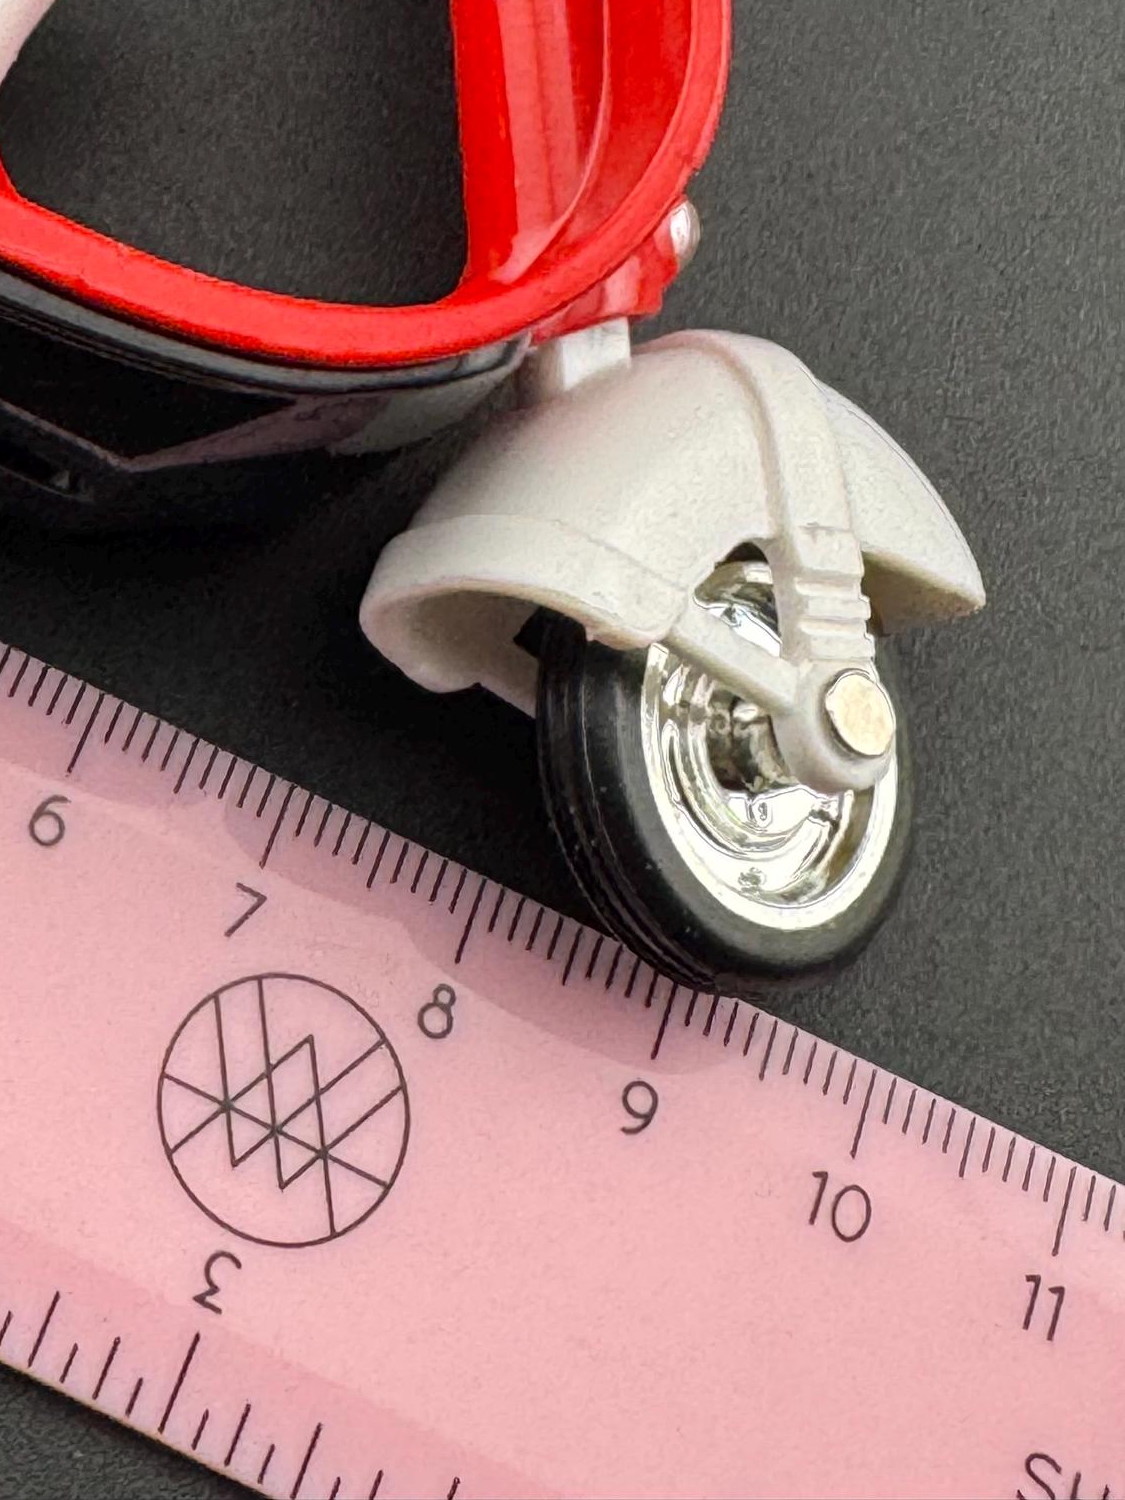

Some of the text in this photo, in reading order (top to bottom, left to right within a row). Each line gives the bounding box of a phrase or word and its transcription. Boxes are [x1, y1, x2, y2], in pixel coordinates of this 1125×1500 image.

[28, 795, 71, 848] 6
[224, 883, 267, 938] 7
[417, 984, 456, 1040] 8
[620, 1081, 658, 1135] 9
[808, 1171, 873, 1243] 10
[1022, 1275, 1065, 1342] 11
[192, 1250, 242, 1315] 3
